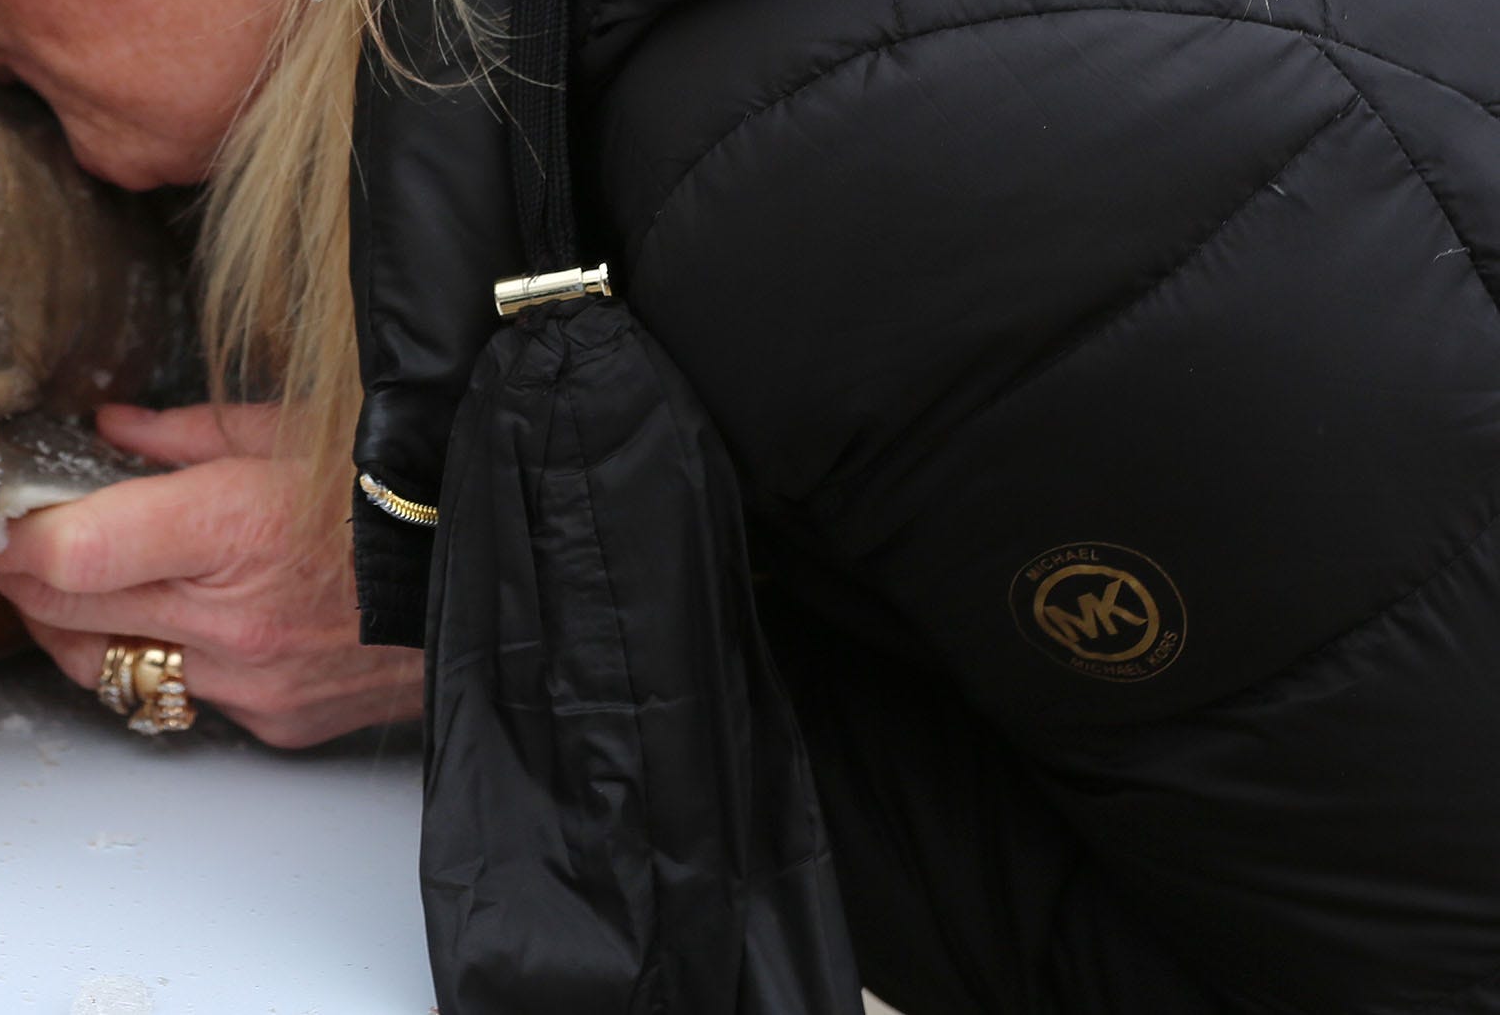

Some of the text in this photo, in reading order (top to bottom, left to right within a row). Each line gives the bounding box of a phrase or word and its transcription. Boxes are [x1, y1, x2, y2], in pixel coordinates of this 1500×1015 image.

[1026, 548, 1100, 581] MICHAEL
[1043, 577, 1149, 644] MK
[1069, 630, 1179, 676] MICHAEL KORS
